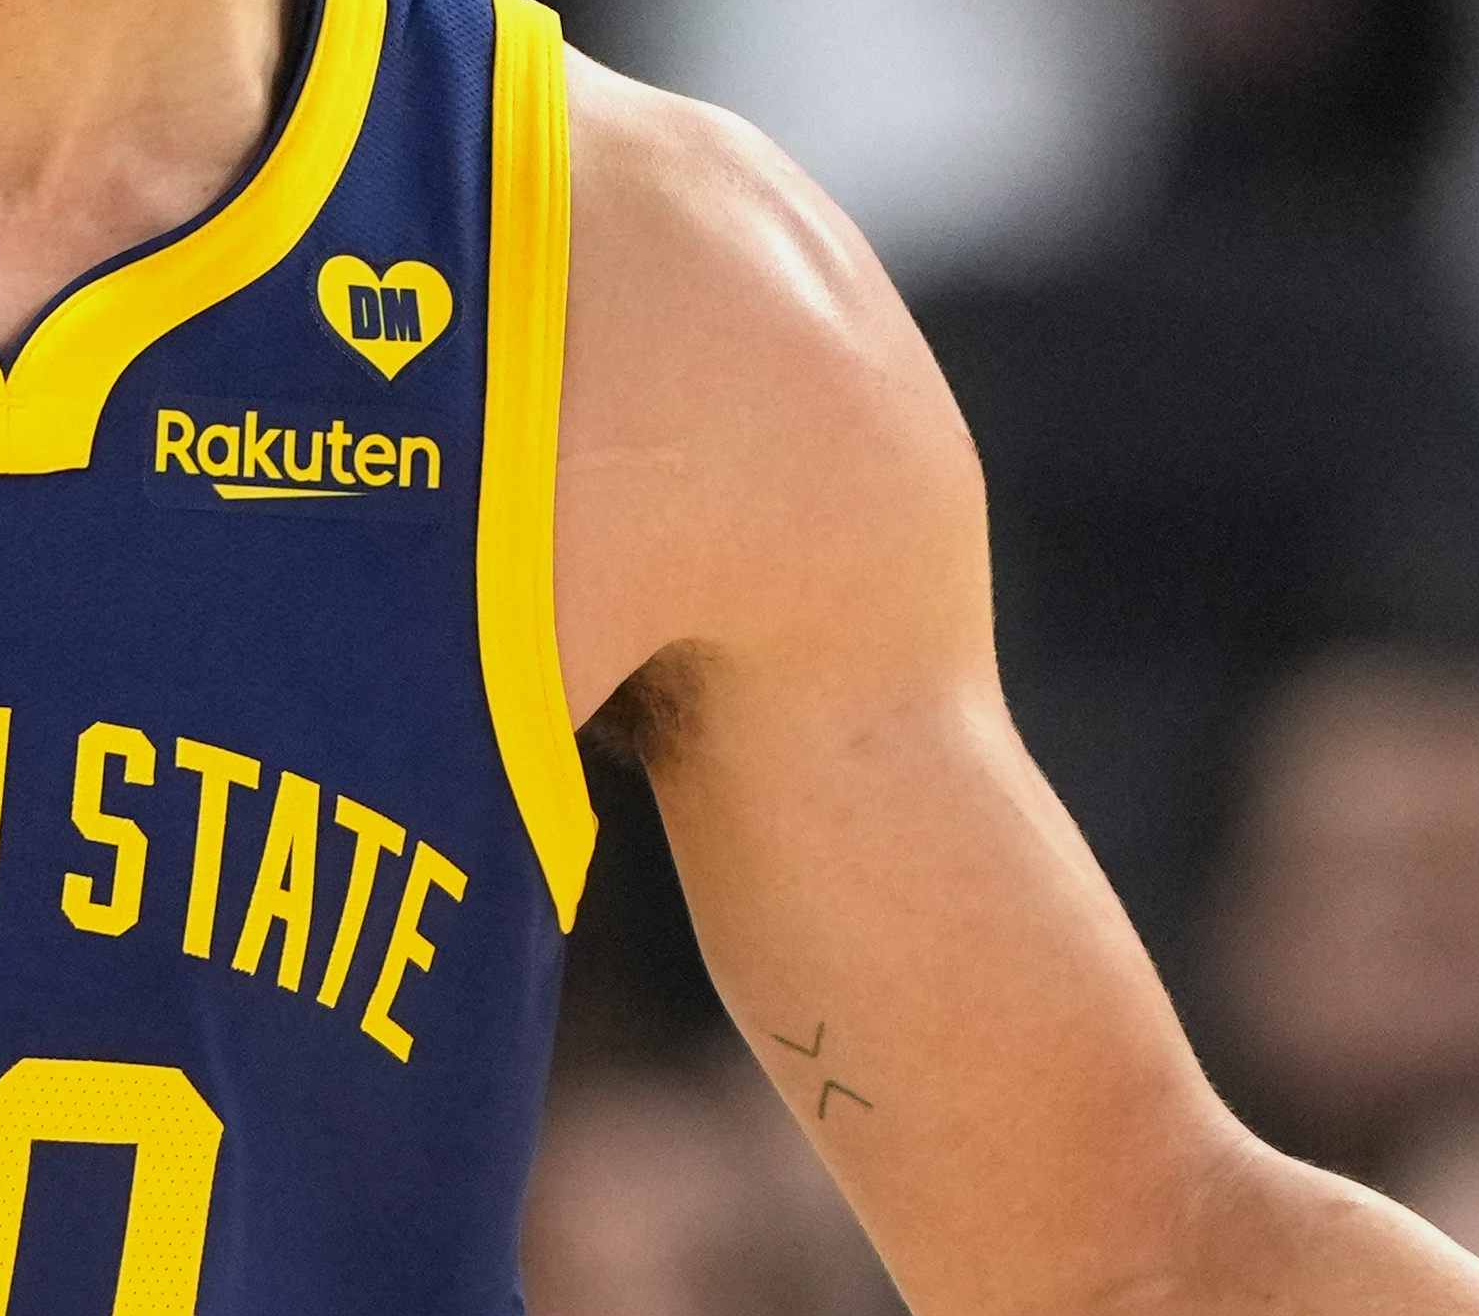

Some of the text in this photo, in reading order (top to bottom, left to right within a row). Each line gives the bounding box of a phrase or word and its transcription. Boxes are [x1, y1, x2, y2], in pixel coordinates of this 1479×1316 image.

[348, 284, 423, 343] DM
[154, 408, 441, 490] Rakuten
[61, 721, 469, 1064] STATE
